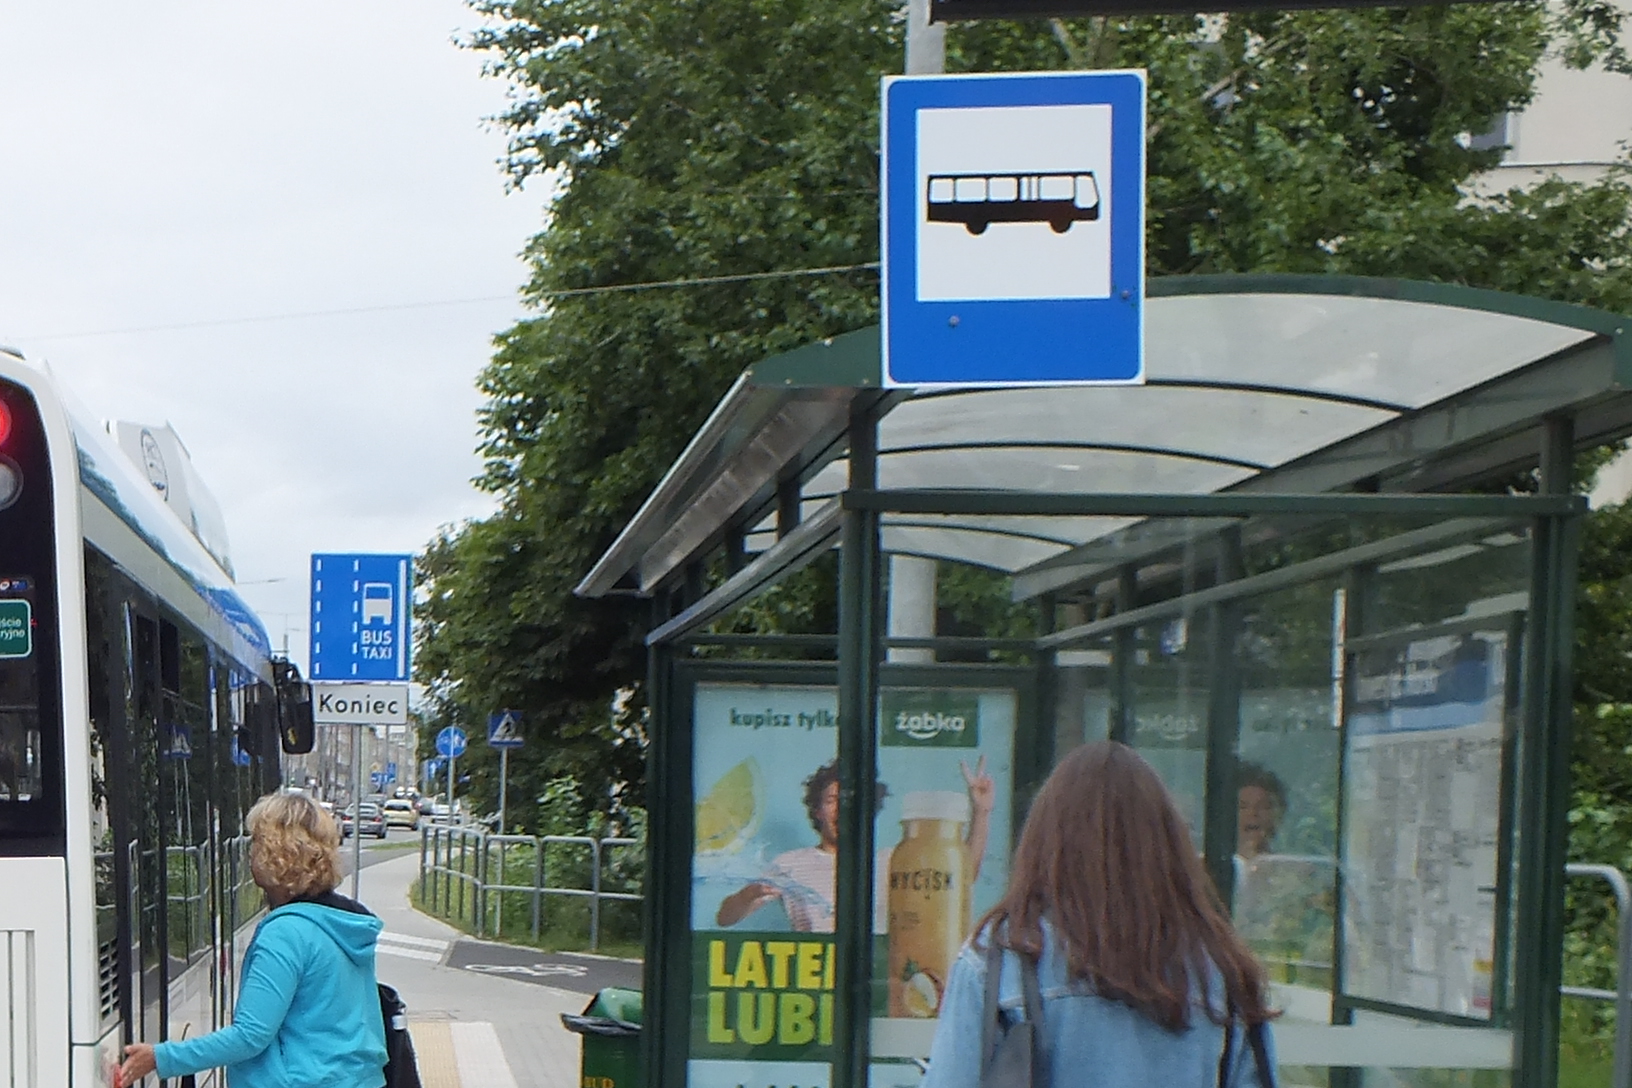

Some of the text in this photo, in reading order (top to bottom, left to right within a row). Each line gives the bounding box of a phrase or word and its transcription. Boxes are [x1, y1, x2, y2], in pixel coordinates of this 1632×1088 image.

[361, 629, 392, 645] BUS
[361, 646, 392, 660] TAXI
[319, 693, 399, 715] Koniec
[729, 707, 792, 729] kupisz
[895, 711, 966, 732] żabka
